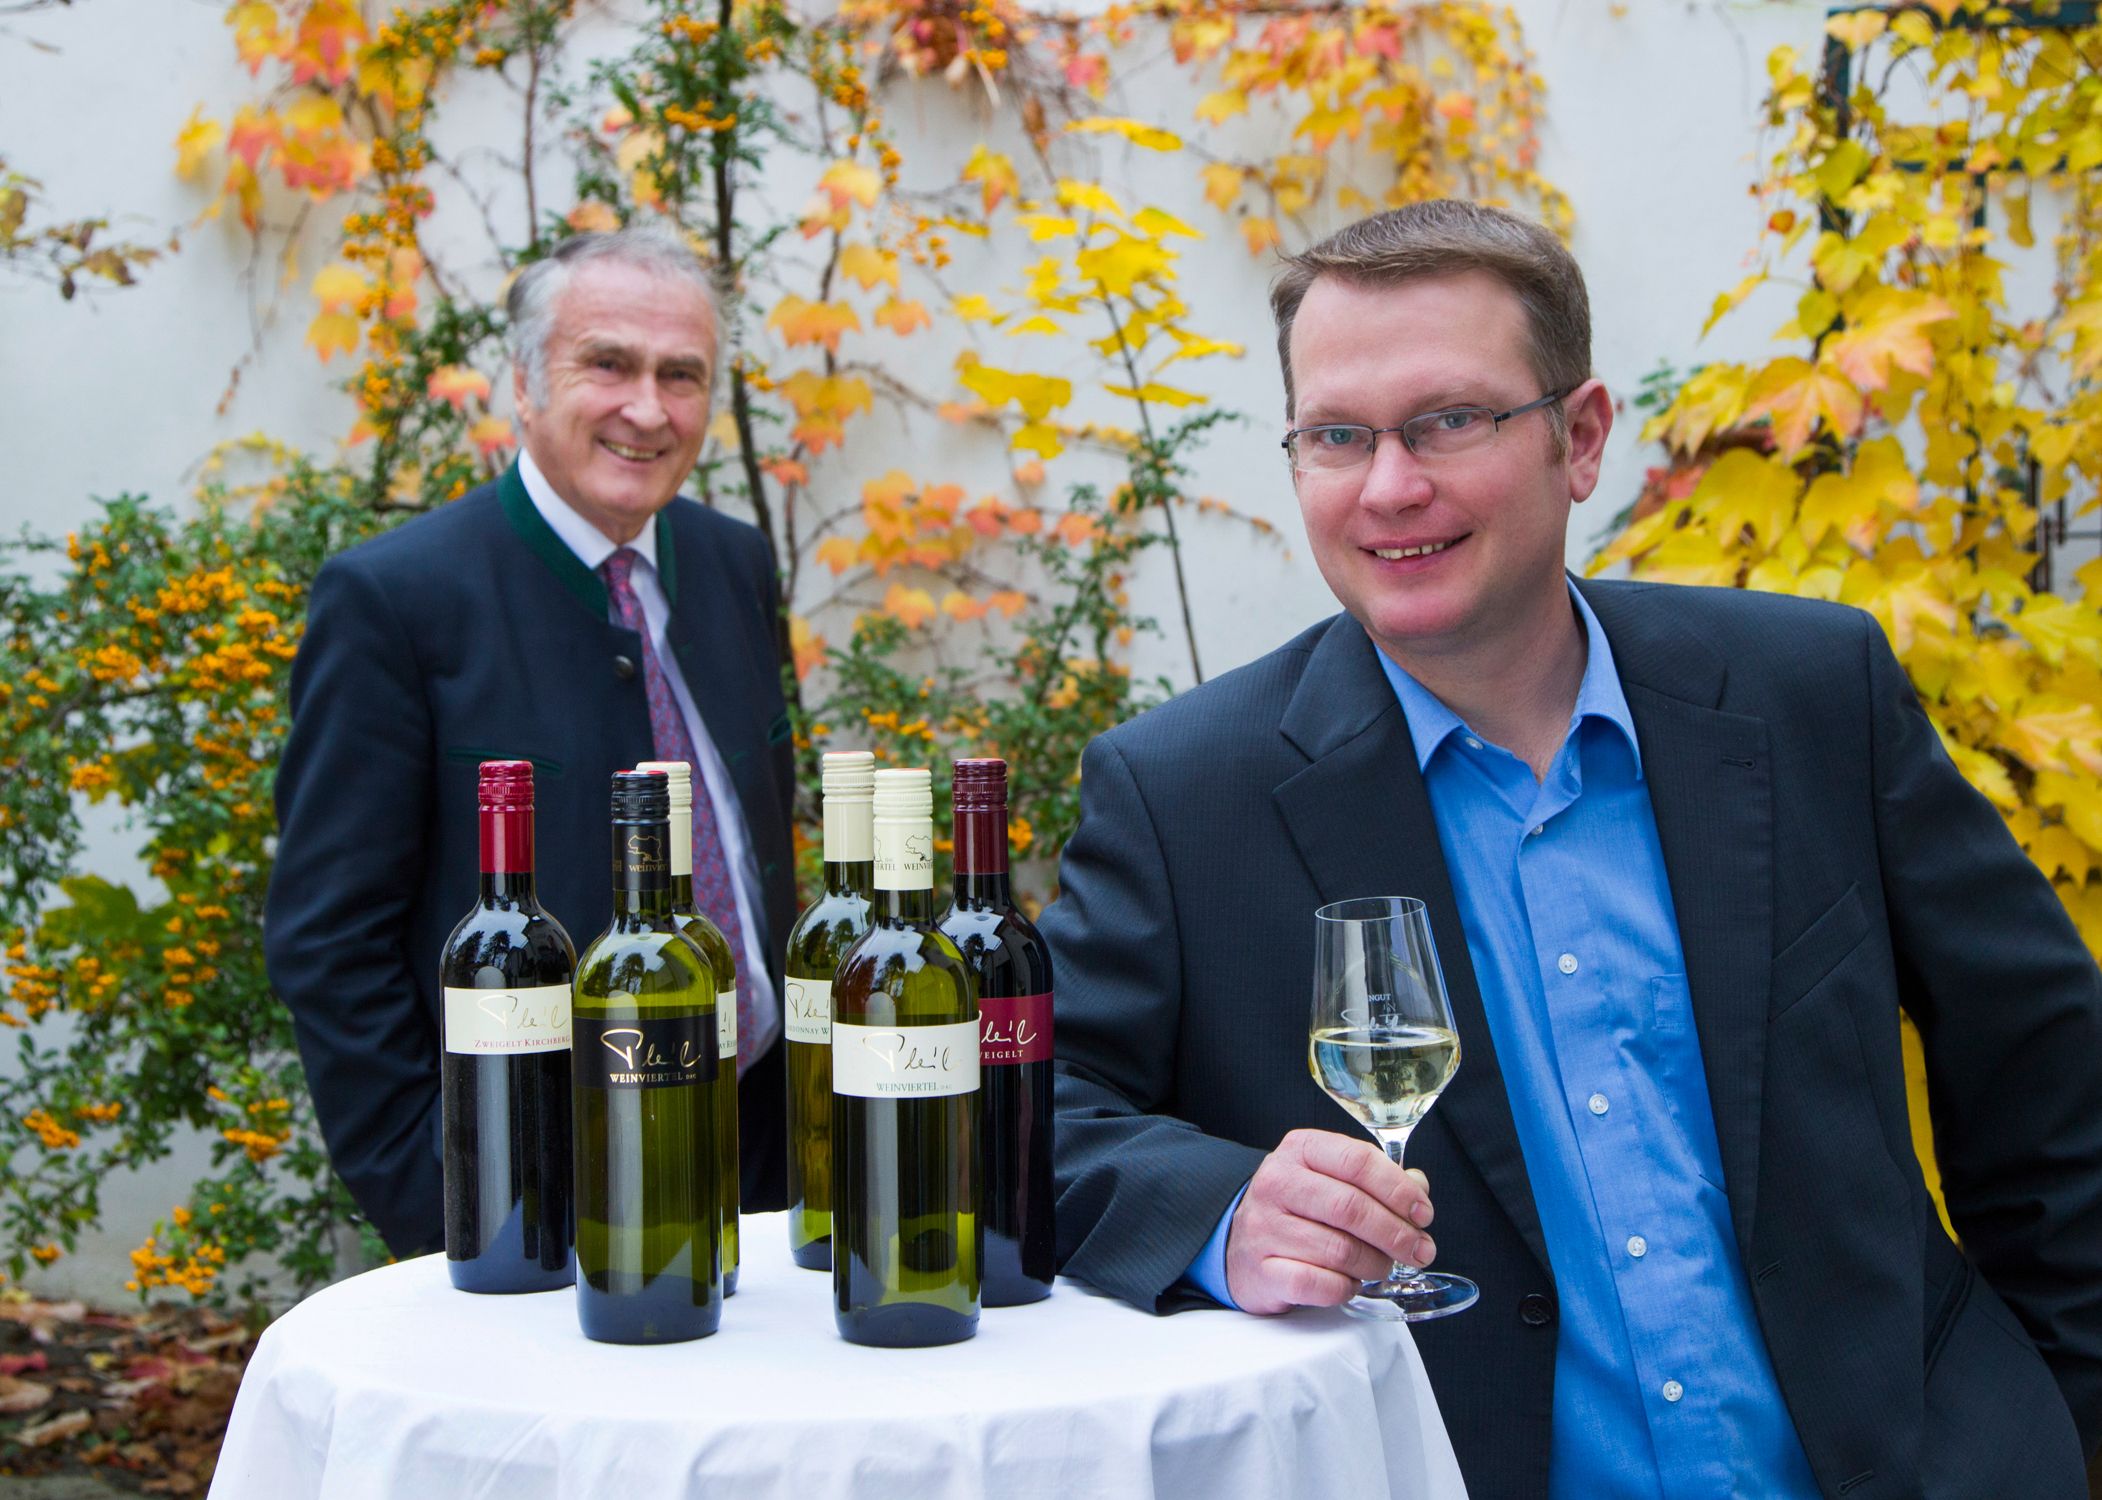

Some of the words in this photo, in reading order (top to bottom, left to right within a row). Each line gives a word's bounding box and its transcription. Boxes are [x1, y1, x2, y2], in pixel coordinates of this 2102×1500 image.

[600, 1028, 702, 1070] Pleil
[980, 1049, 1024, 1060] EIGELT
[609, 1072, 684, 1084] WEINVIERTEL
[876, 1081, 938, 1092] WEINVIERTEL
